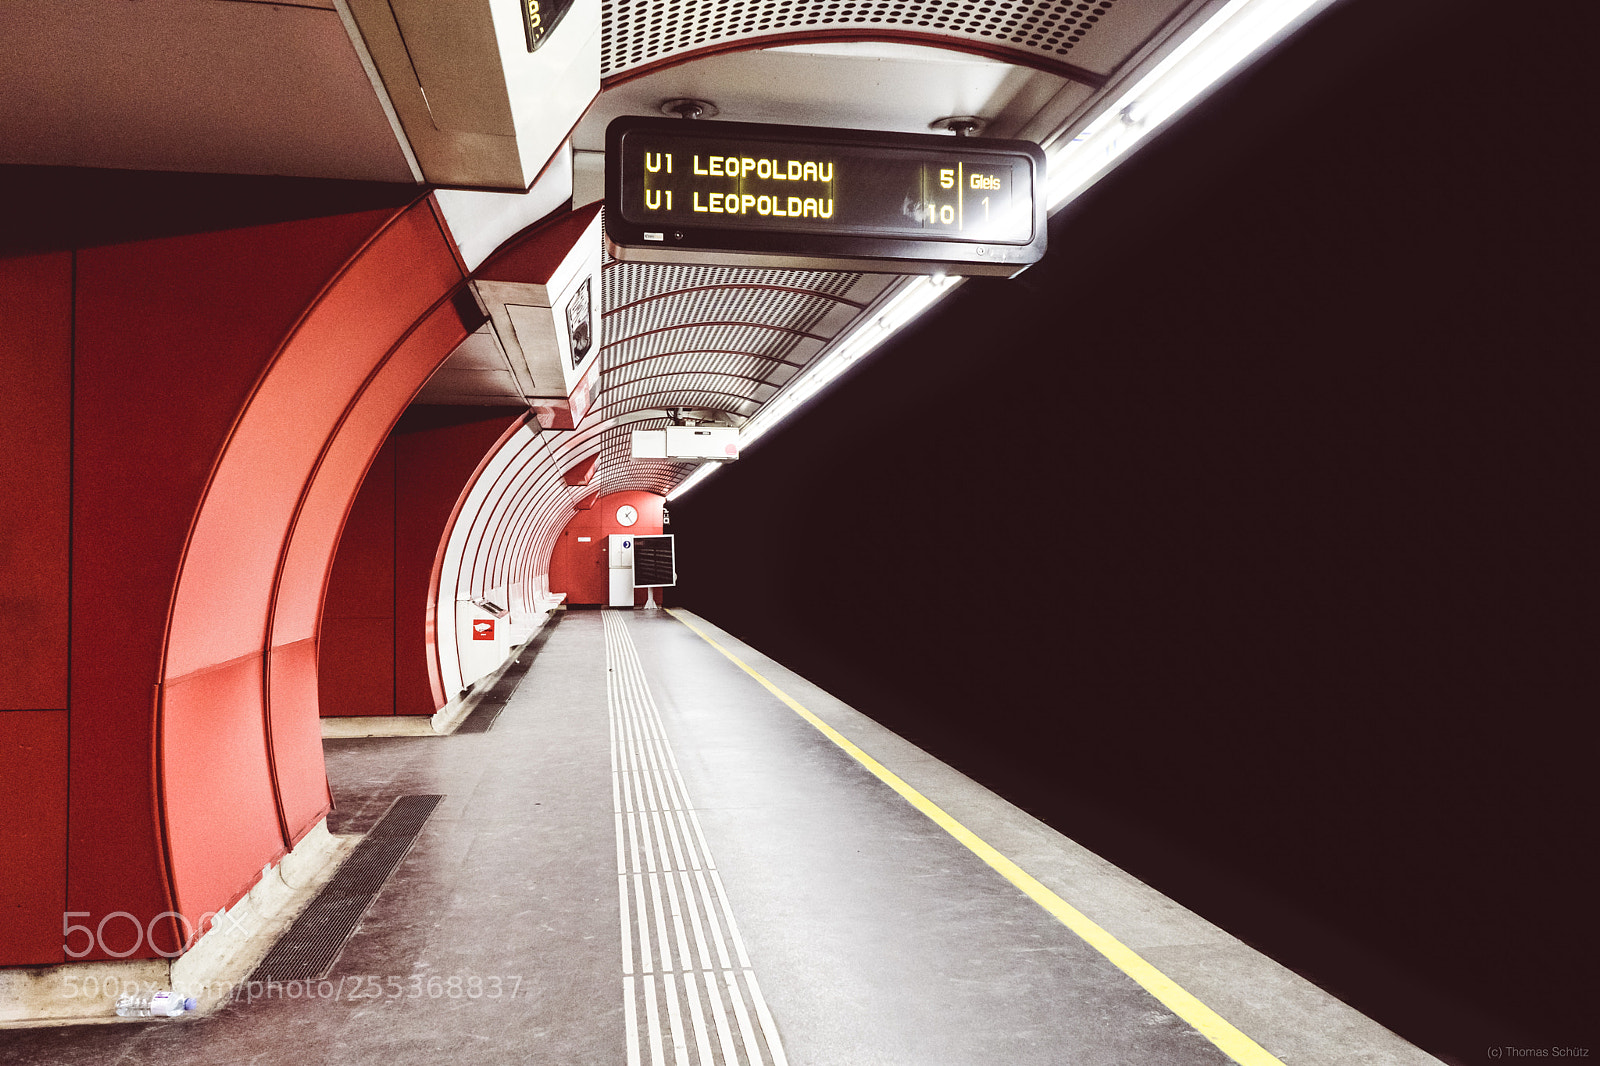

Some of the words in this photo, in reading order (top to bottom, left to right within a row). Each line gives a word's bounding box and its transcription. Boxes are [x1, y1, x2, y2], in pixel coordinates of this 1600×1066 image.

[645, 152, 672, 173] U1
[693, 155, 834, 182] LEOPOLDAU
[940, 168, 955, 189] 5
[970, 173, 1001, 191] Gleis
[645, 189, 672, 210] U1
[693, 192, 834, 219] LEOPOLDAU
[928, 204, 955, 225] 10
[981, 196, 991, 222] 1
